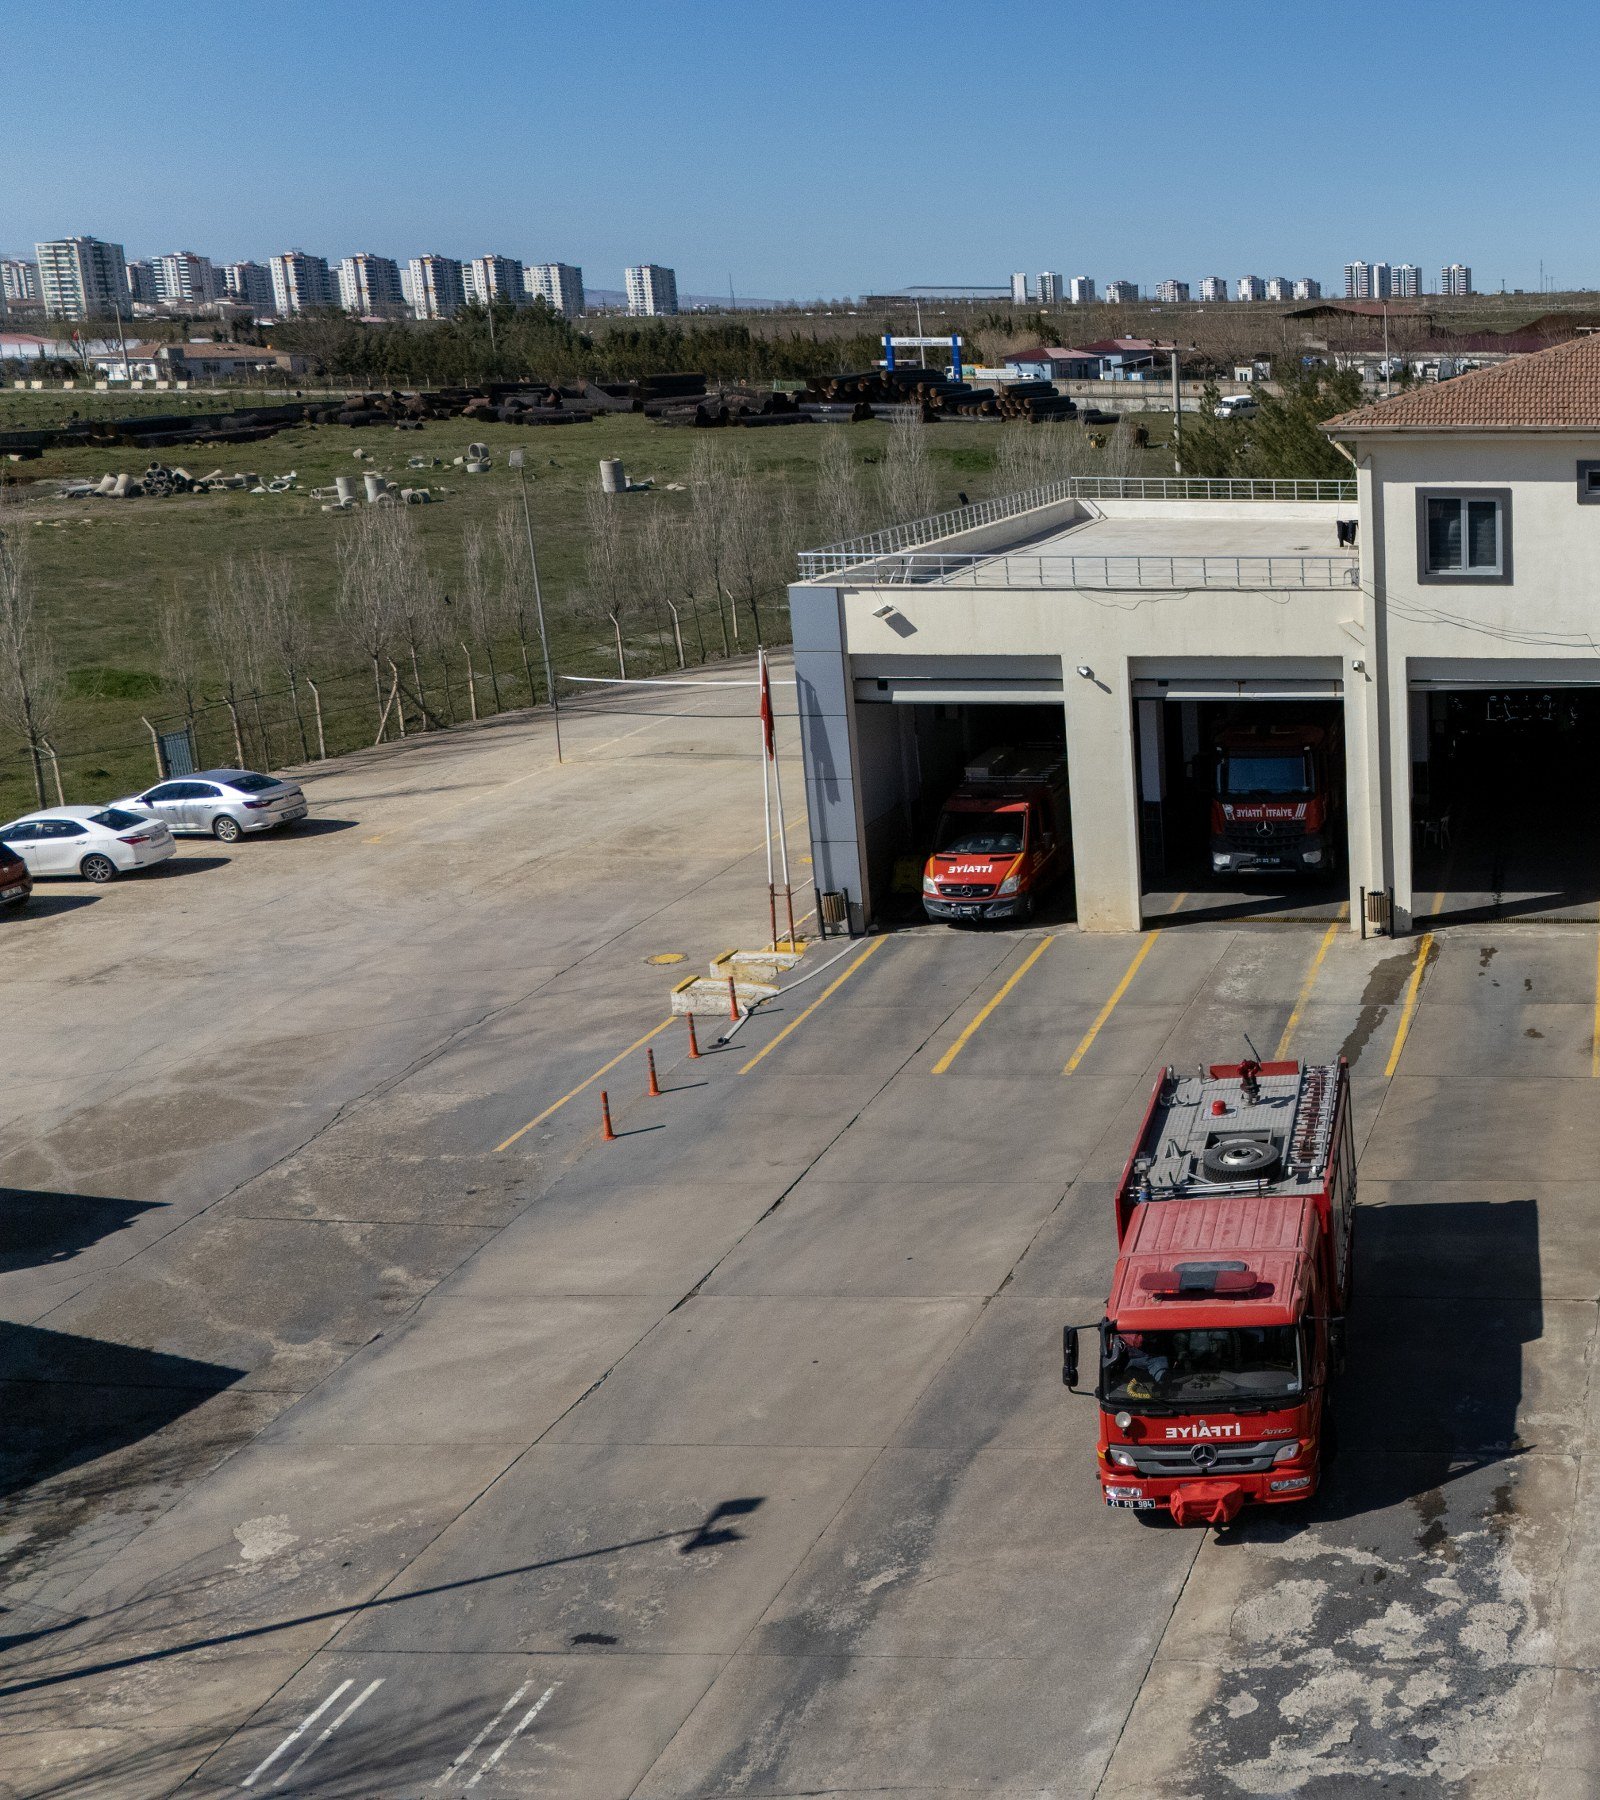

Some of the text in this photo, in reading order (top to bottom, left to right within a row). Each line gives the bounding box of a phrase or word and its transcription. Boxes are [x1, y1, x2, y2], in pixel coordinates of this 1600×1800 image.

[1266, 806, 1293, 818] İTFAİYE
[1110, 1499, 1119, 1507] 21
[1124, 1500, 1134, 1508] FU
